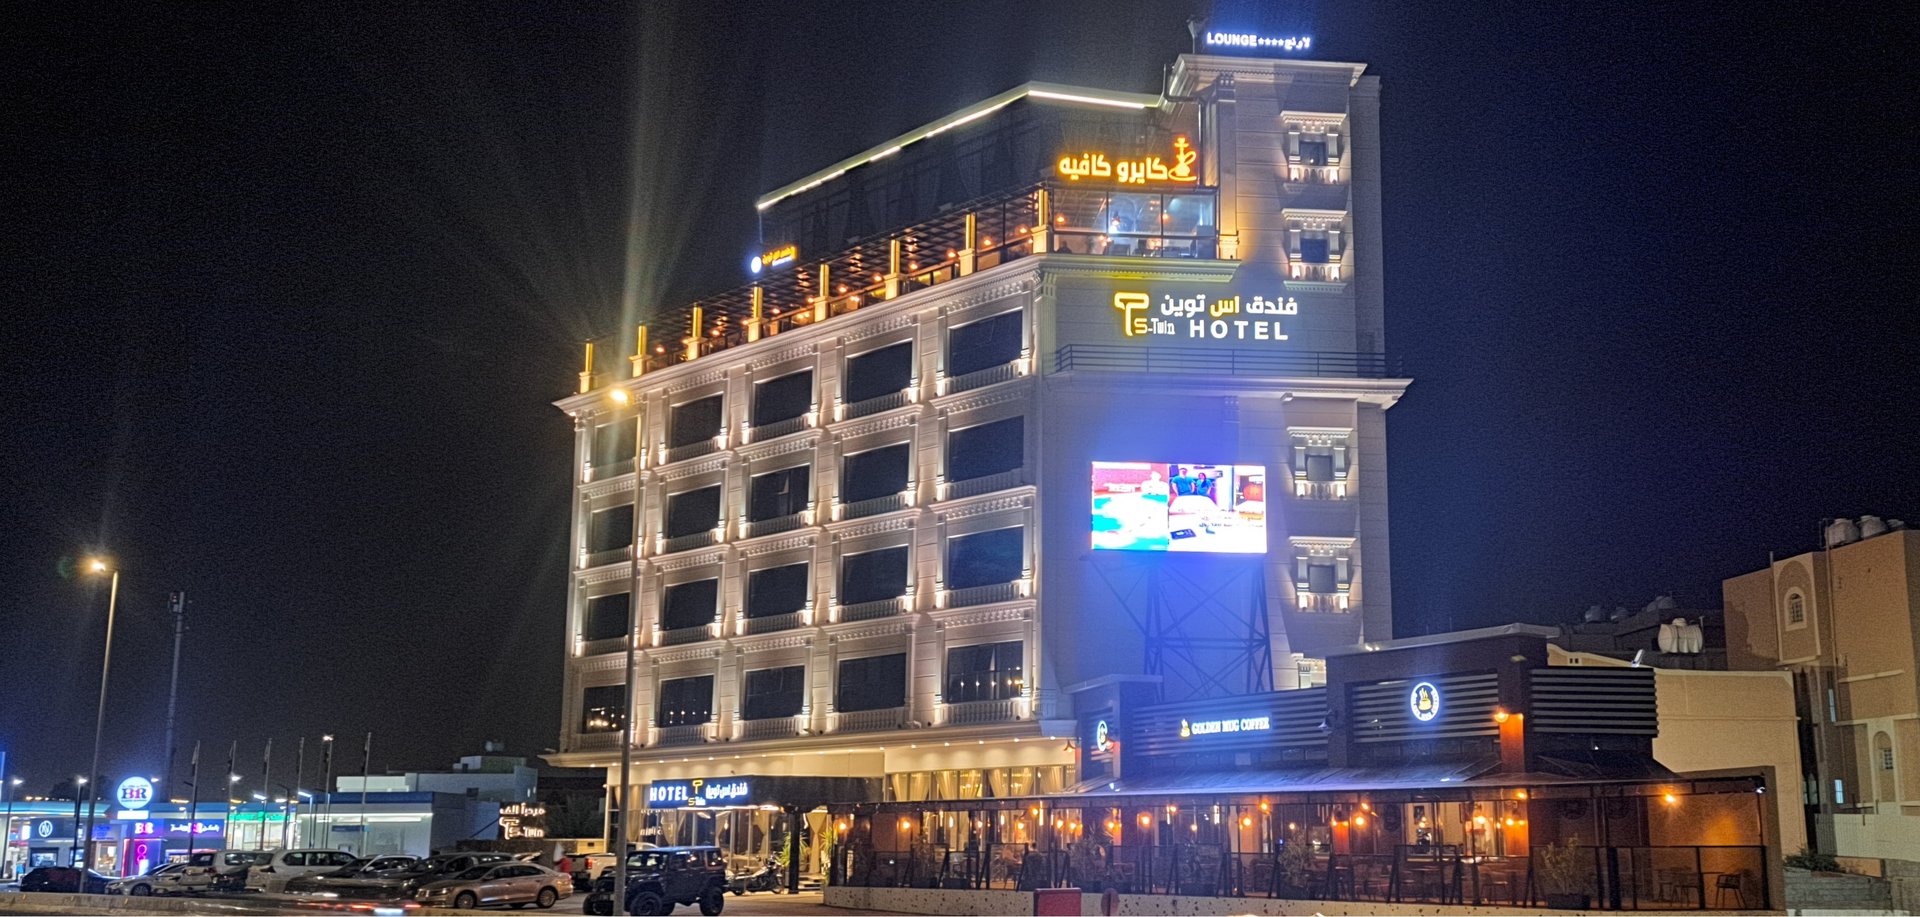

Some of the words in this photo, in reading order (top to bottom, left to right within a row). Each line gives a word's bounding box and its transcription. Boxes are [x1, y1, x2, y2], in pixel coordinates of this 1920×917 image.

[1206, 32, 1257, 47] LOUNGE
[1059, 153, 1112, 181] كافيه
[1116, 156, 1168, 184] كايرو
[1160, 294, 1206, 318] توين
[1209, 295, 1241, 318] اس
[1246, 295, 1298, 316] فندق
[1189, 319, 1289, 341] HOTEL
[1191, 720, 1221, 735] GOLDEN
[1241, 716, 1270, 731] COFFEE
[649, 785, 689, 802] HOTEL
